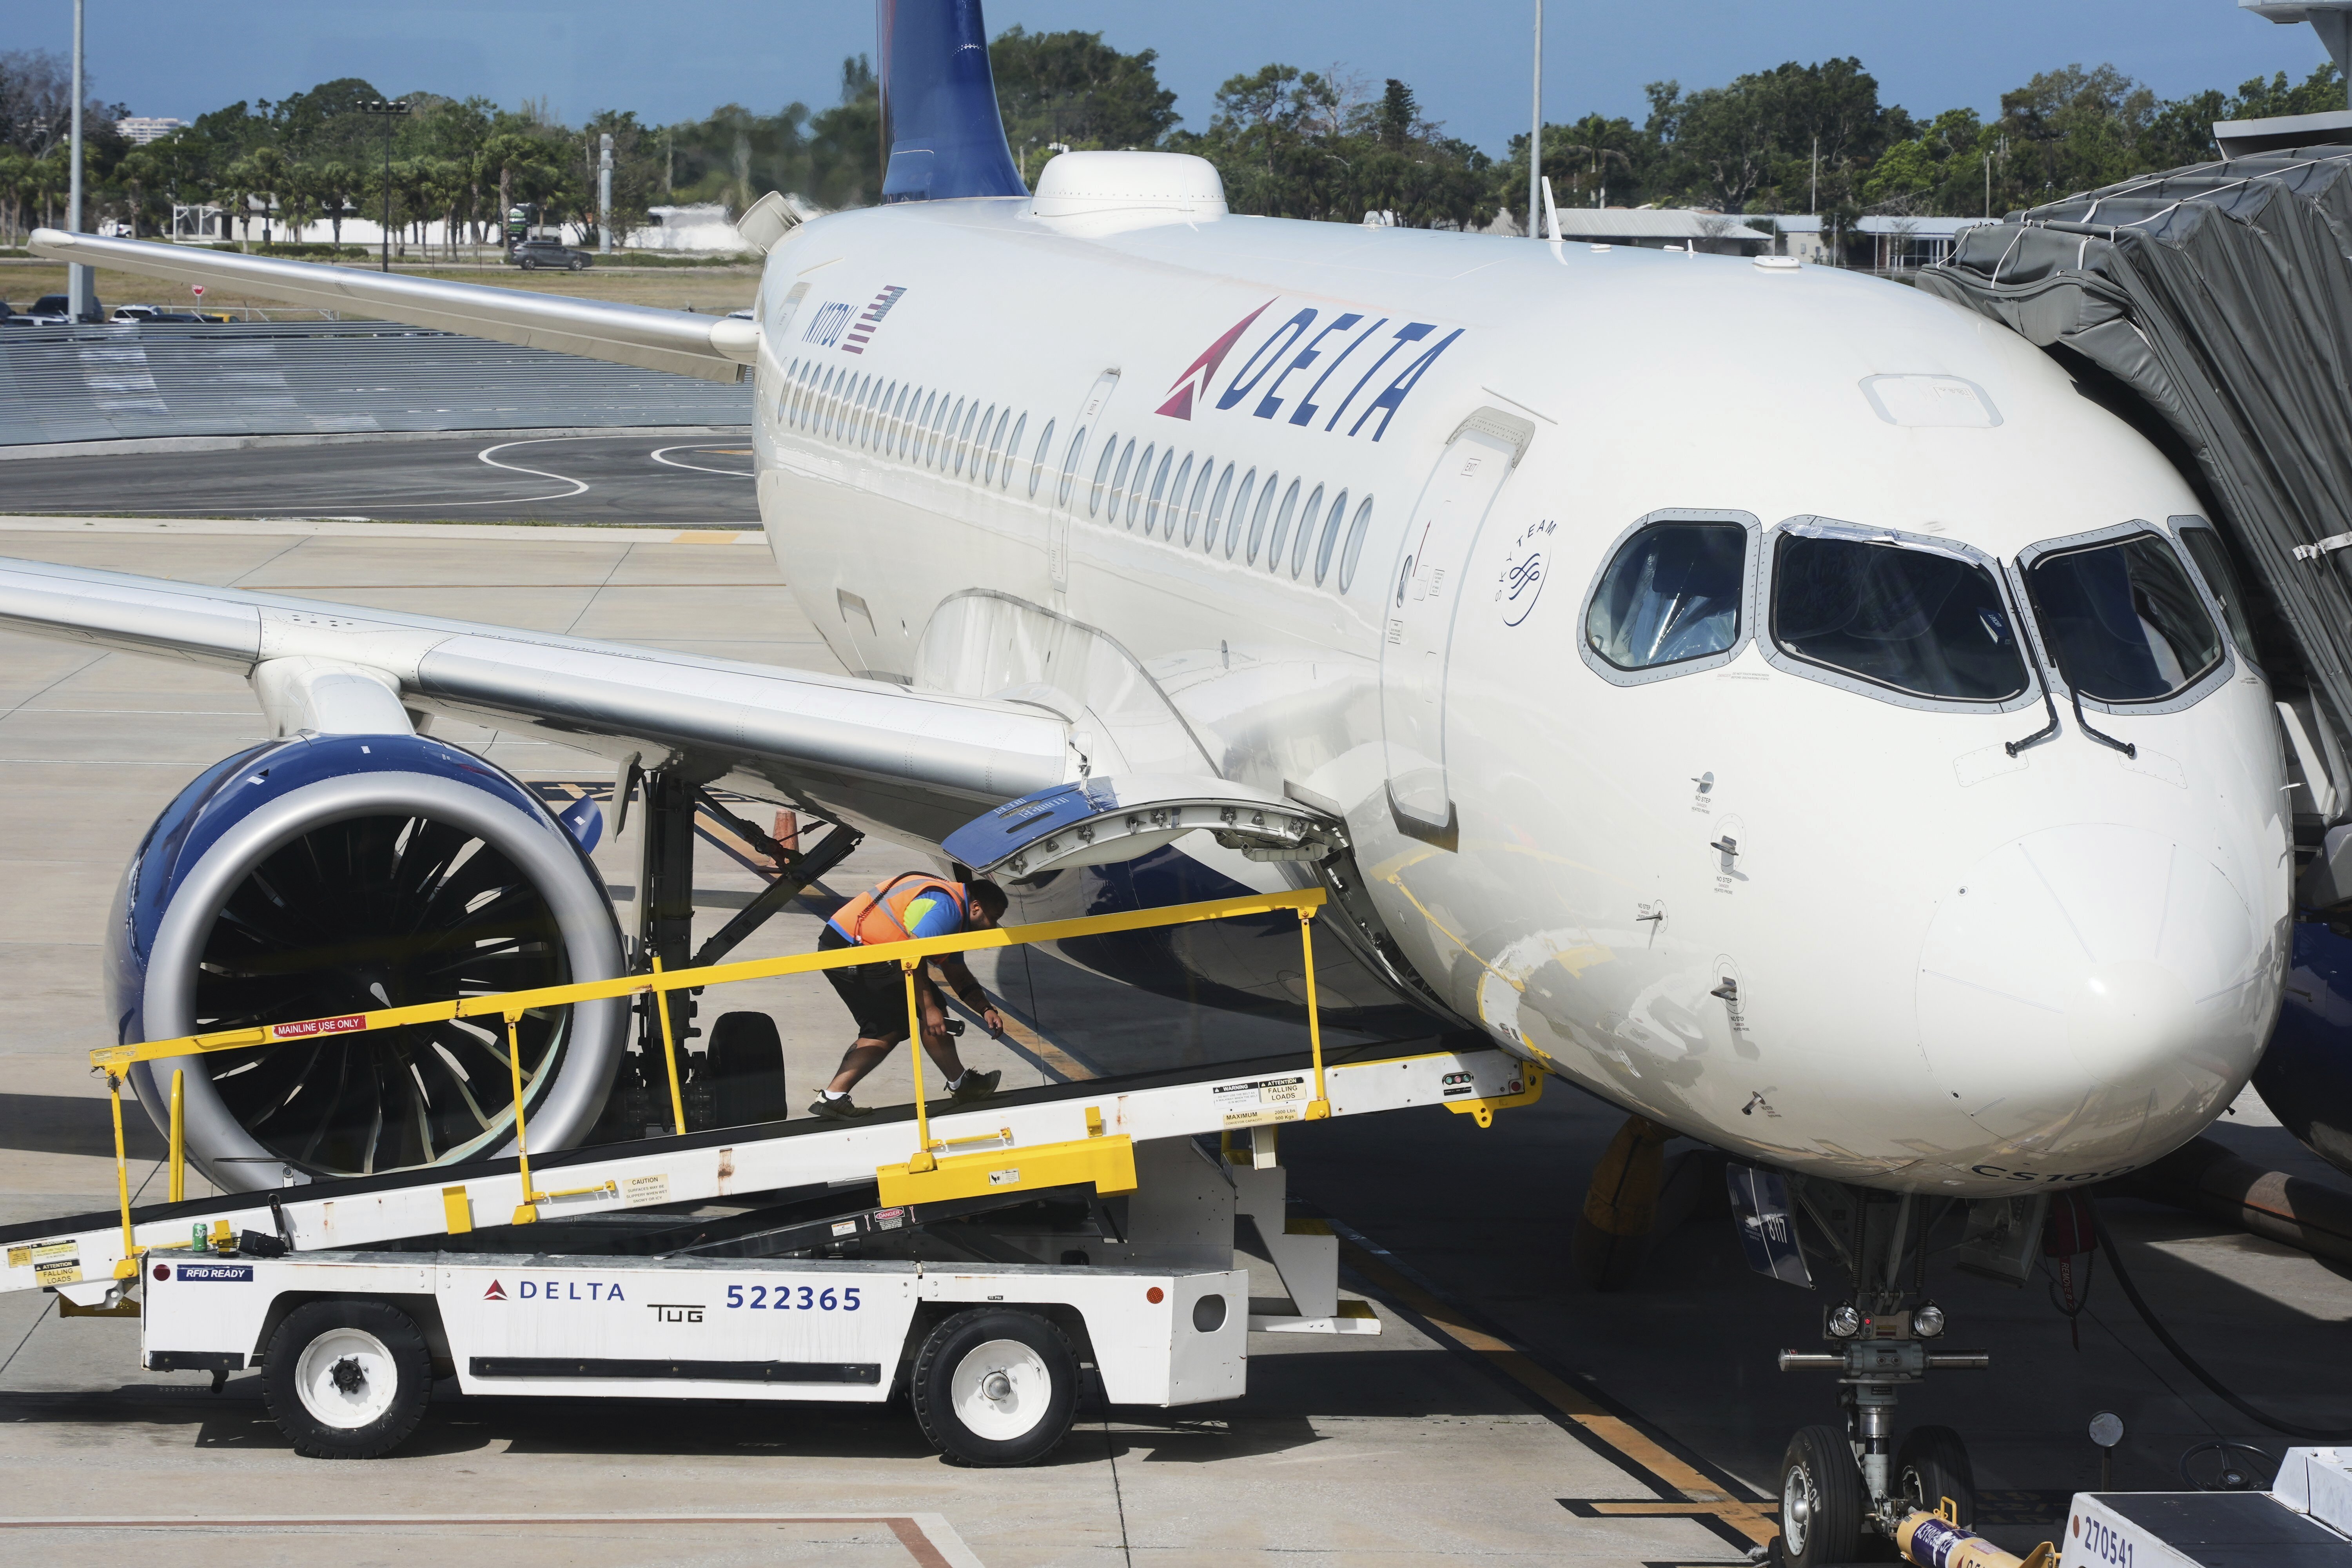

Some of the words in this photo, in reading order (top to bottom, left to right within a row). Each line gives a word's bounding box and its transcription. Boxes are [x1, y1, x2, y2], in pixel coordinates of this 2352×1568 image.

[1216, 308, 1465, 442] DELTA
[1465, 462, 1477, 473] EXIT
[540, 642, 595, 652] OUTSIDE
[278, 1023, 316, 1034] MAINLINE
[319, 1021, 335, 1030] USE
[337, 1018, 359, 1028] ONLY
[1268, 1085, 1298, 1094] FALLING
[1227, 1112, 1258, 1120] MAXIMUM
[1971, 1164, 2135, 1182] CS100
[1767, 1214, 1788, 1243] 8117
[42, 1261, 72, 1269] ATTENTION
[44, 1268, 73, 1277] FALLING
[47, 1276, 71, 1284] LOADS
[2061, 1262, 2072, 1293] REMOVE
[520, 1281, 625, 1301] DELTA
[726, 1285, 861, 1311] 522365
[647, 1304, 706, 1323] TUG
[2085, 1516, 2132, 1568] 270541
